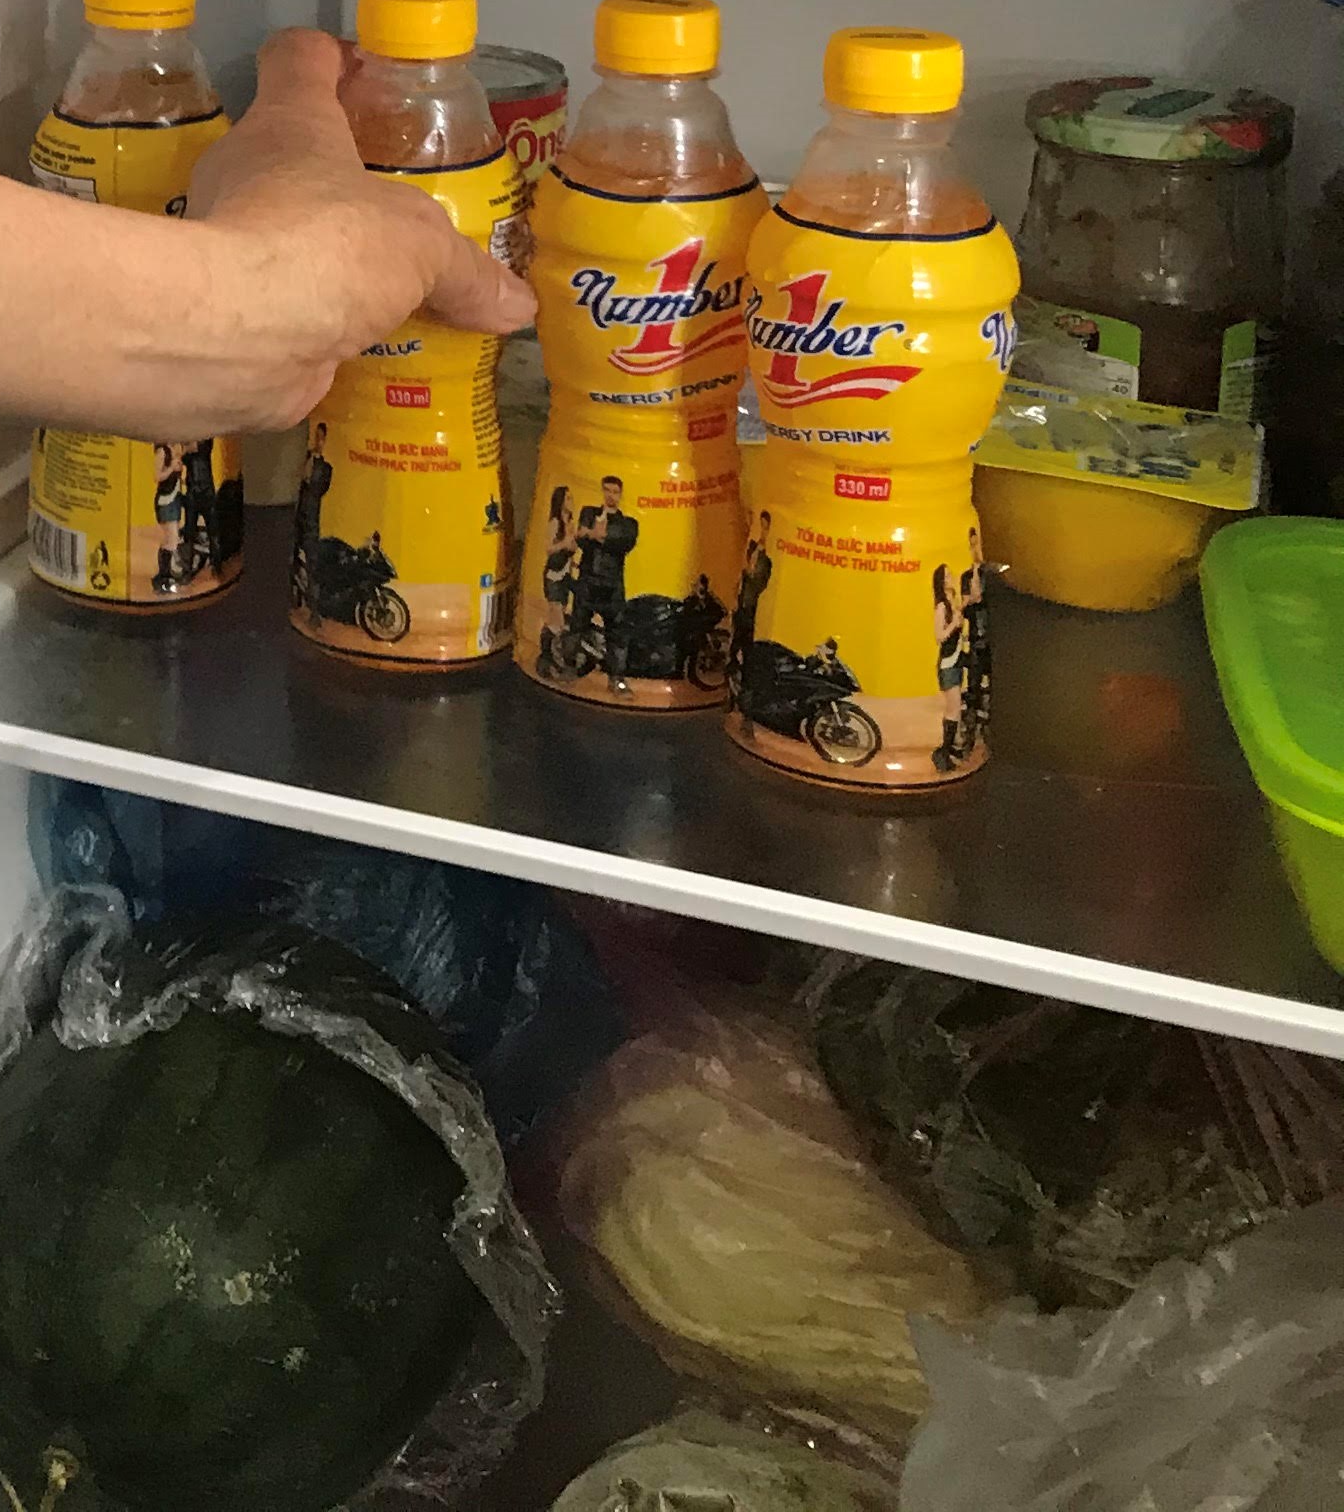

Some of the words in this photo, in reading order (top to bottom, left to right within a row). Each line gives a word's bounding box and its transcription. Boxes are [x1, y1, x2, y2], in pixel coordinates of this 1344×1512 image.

[571, 261, 750, 329] Number
[389, 390, 411, 404] 330
[413, 390, 429, 404] ml
[589, 389, 679, 405] ENERGY
[818, 430, 891, 443] DRINK
[838, 478, 865, 495] 330
[868, 482, 888, 497] ml
